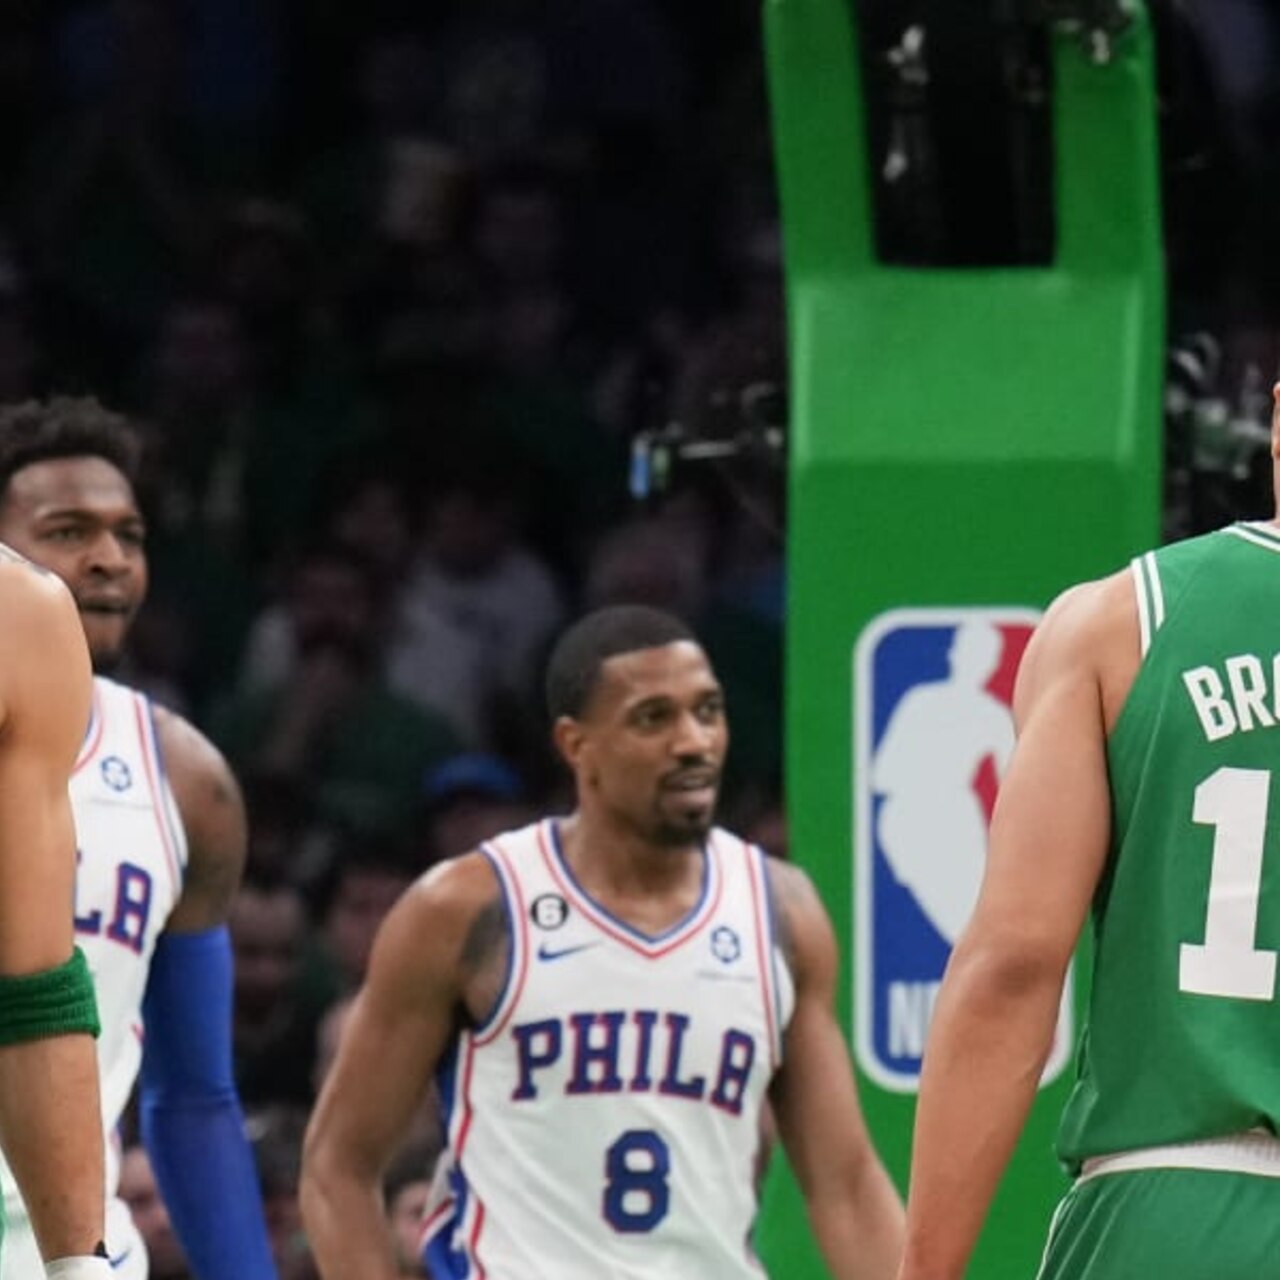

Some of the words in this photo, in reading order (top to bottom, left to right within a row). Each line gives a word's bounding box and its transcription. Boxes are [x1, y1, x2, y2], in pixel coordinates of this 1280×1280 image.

[1182, 644, 1280, 742] BR
[535, 896, 565, 928] 6
[1179, 766, 1278, 1001] 1
[512, 1010, 756, 1117] PHILA
[602, 1129, 671, 1234] 8
